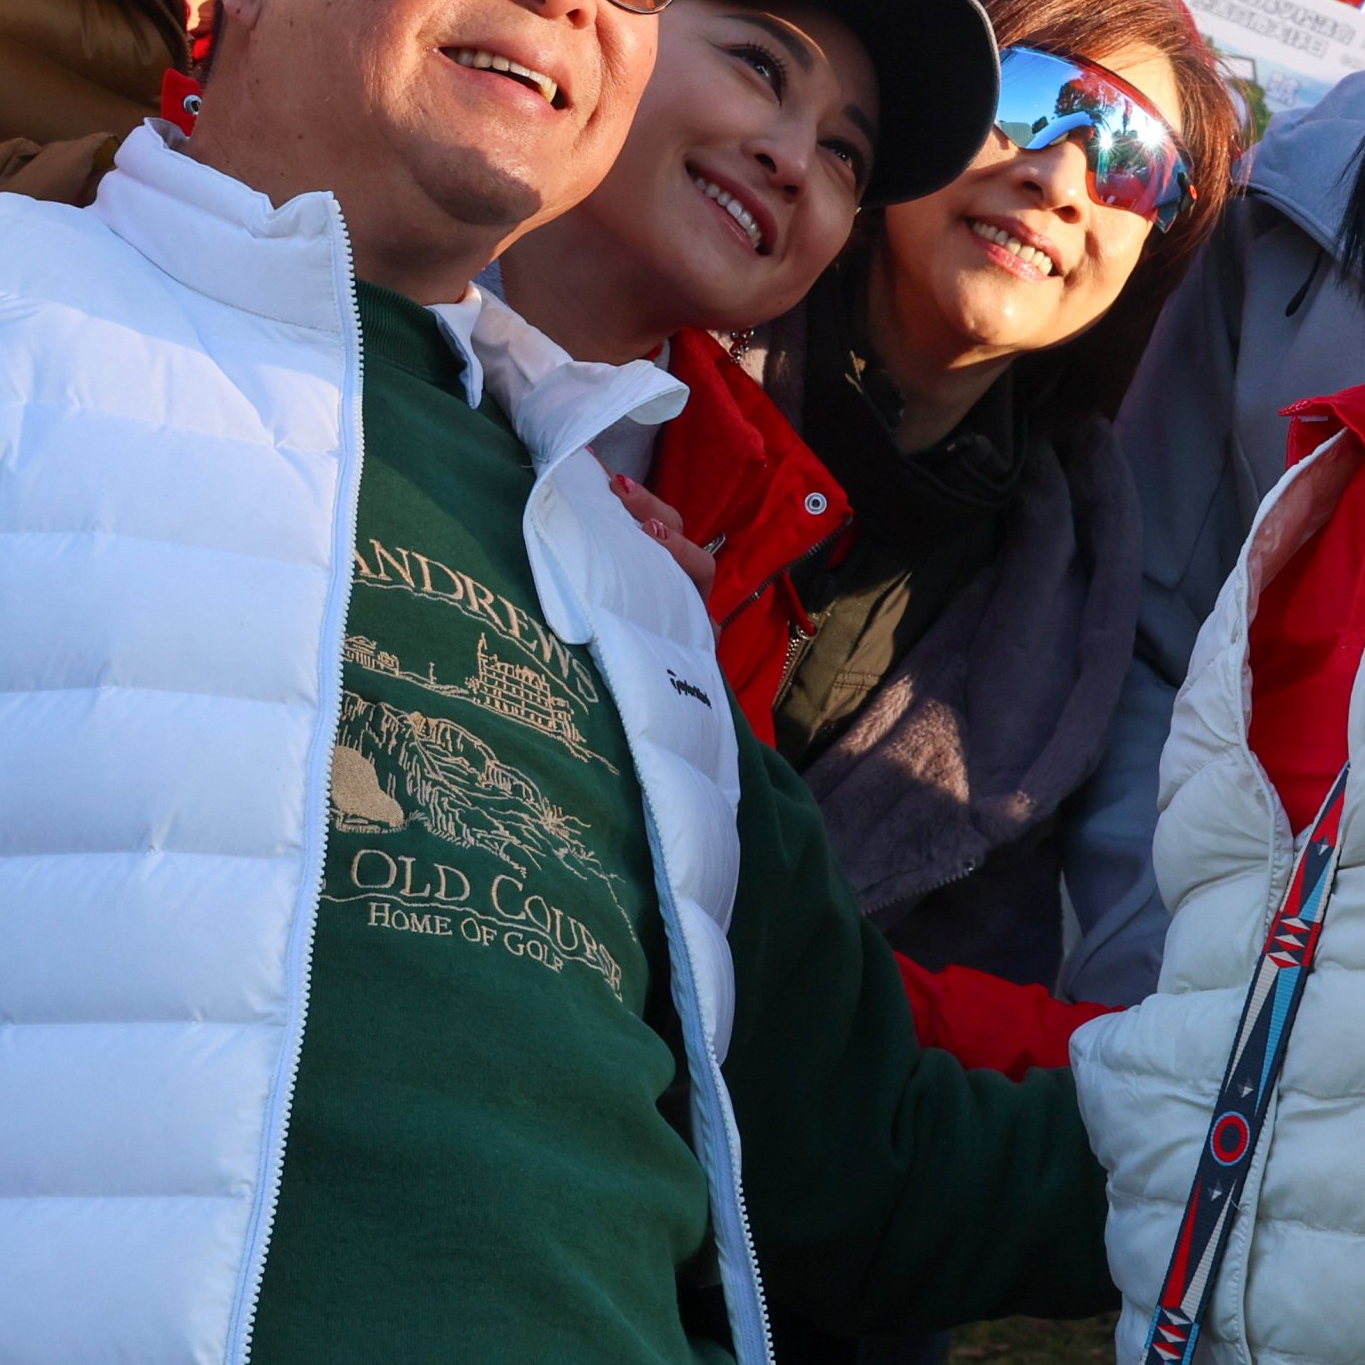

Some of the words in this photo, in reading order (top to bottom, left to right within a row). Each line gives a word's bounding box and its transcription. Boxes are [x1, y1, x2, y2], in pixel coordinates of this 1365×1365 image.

[350, 848, 471, 902] OLD
[367, 901, 452, 935] HOME
[460, 917, 497, 947] OF
